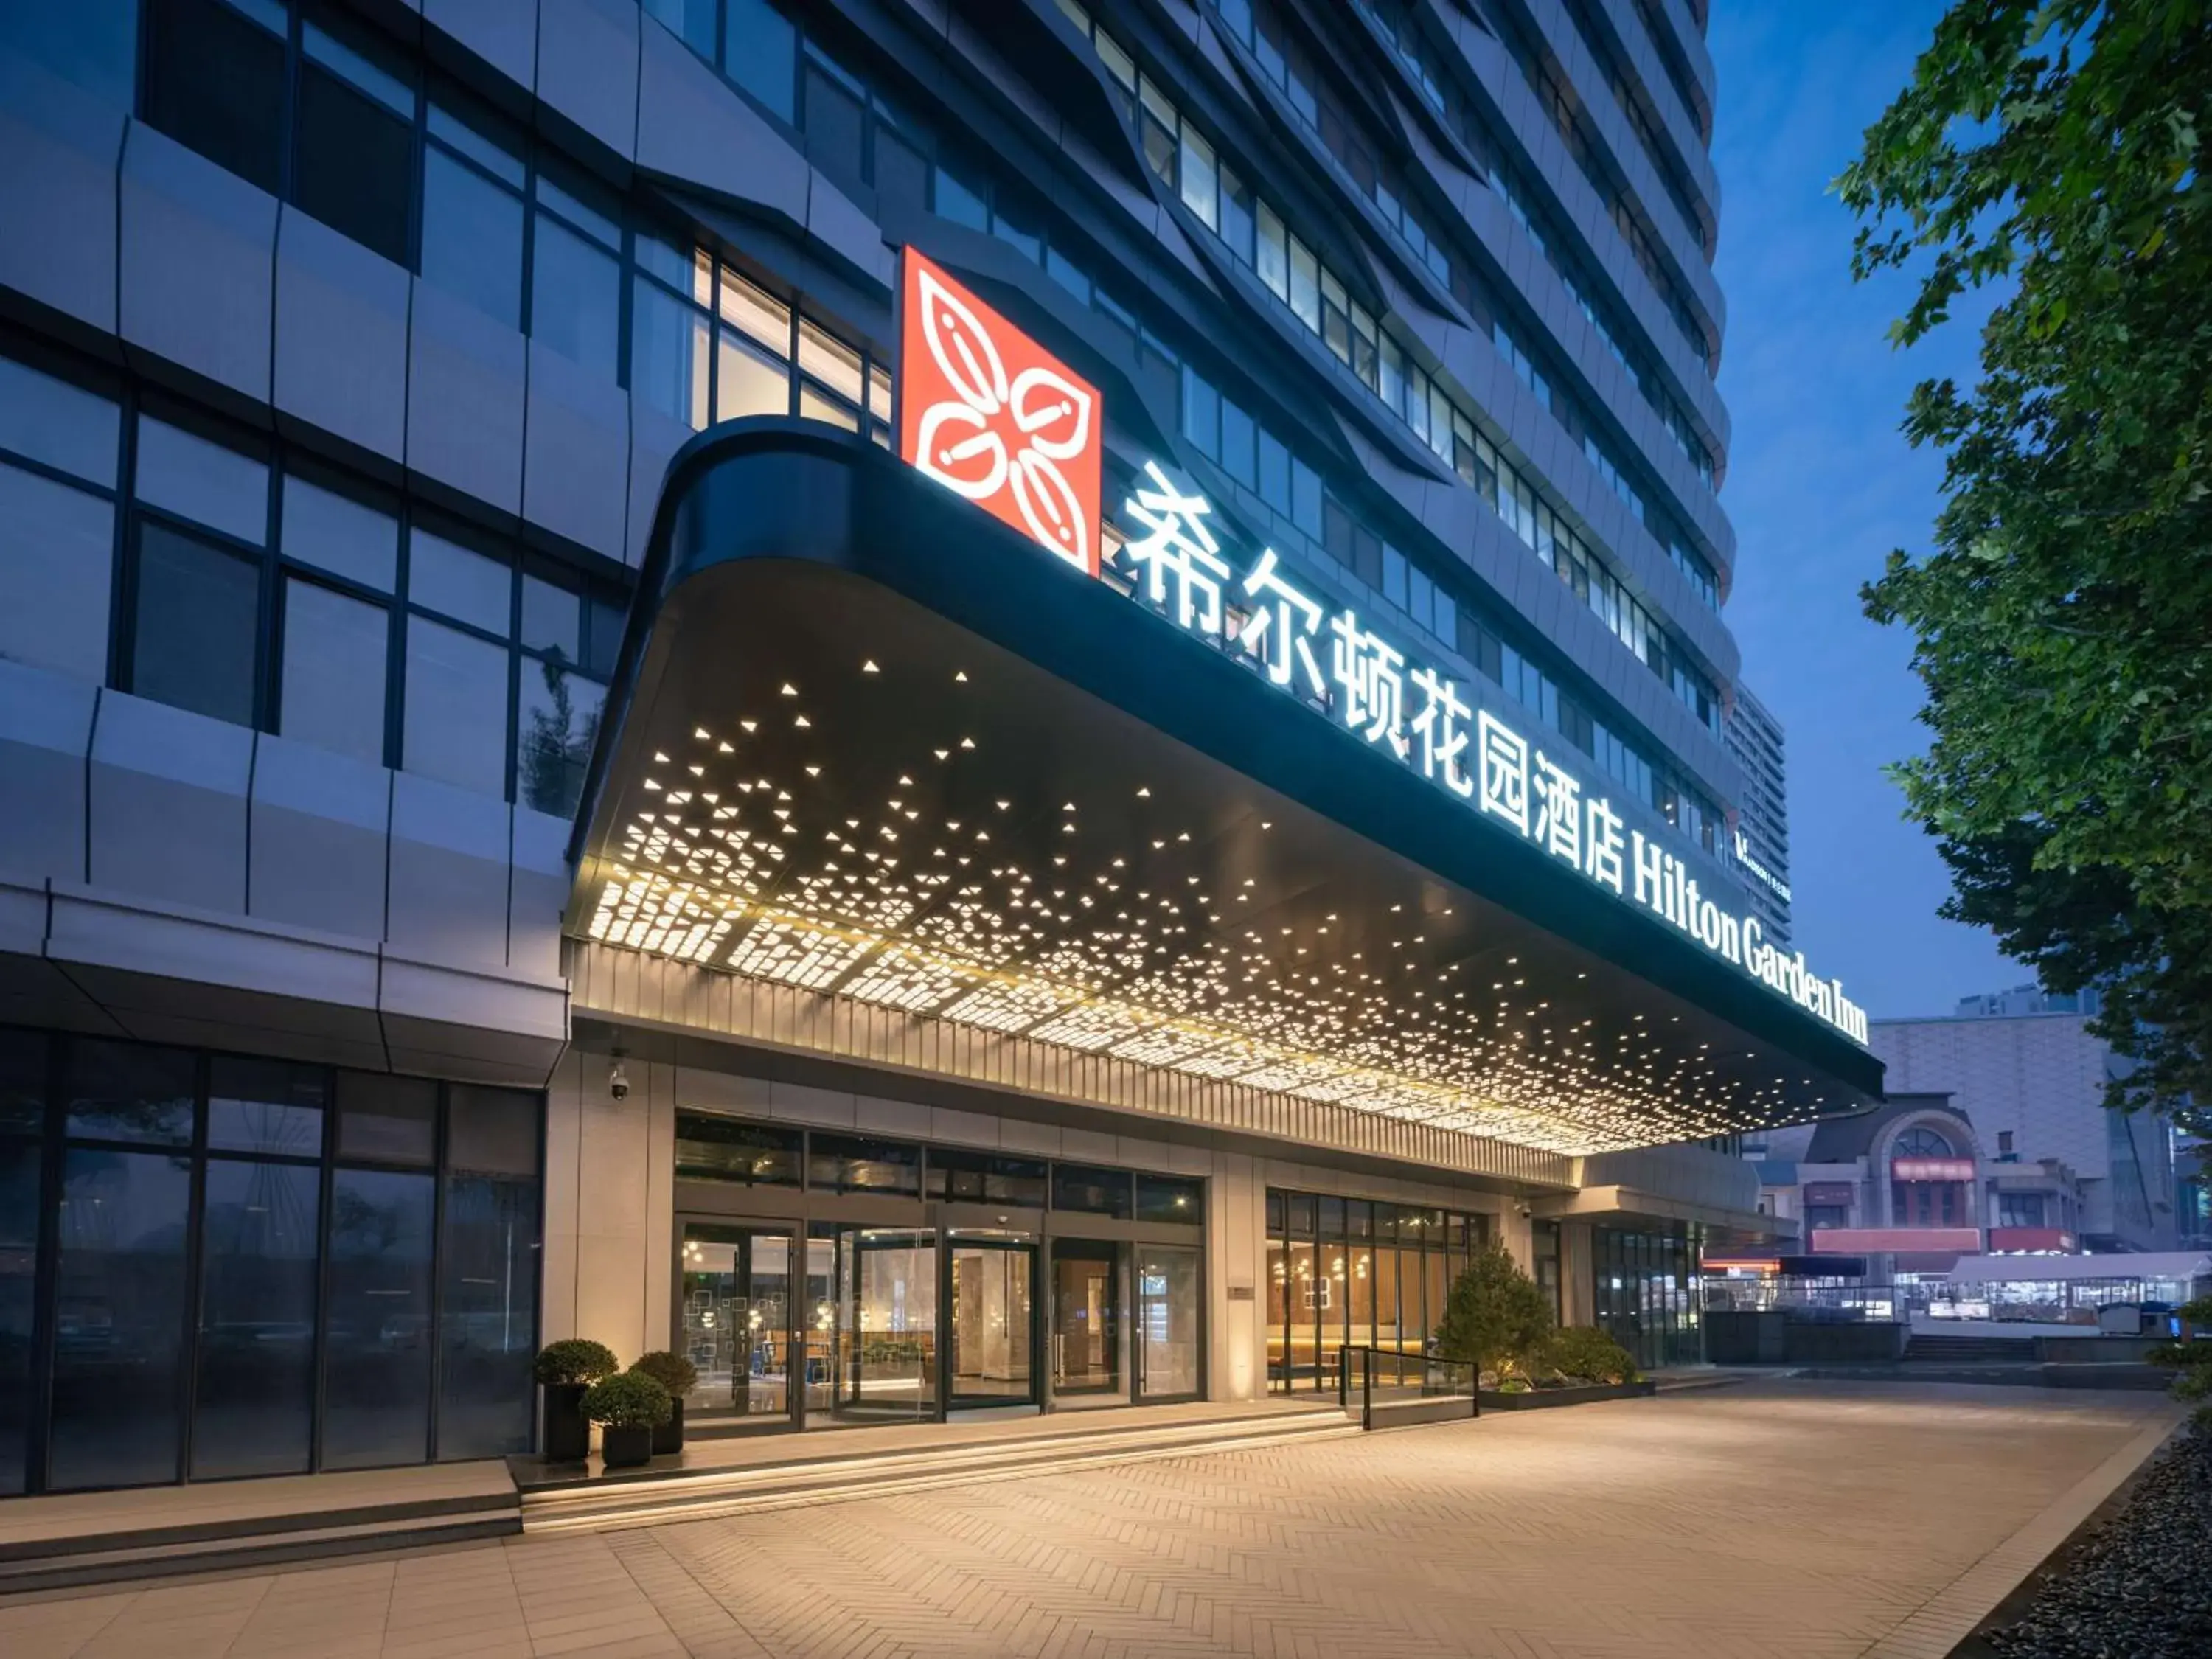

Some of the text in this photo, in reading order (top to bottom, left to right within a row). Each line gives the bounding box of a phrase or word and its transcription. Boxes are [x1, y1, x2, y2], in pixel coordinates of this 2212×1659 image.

[1125, 460, 1624, 895] 希尔顿花园酒店
[1632, 830, 1741, 964] Hilton
[1743, 917, 1834, 1023] Garden
[1832, 978, 1869, 1046] Inn
